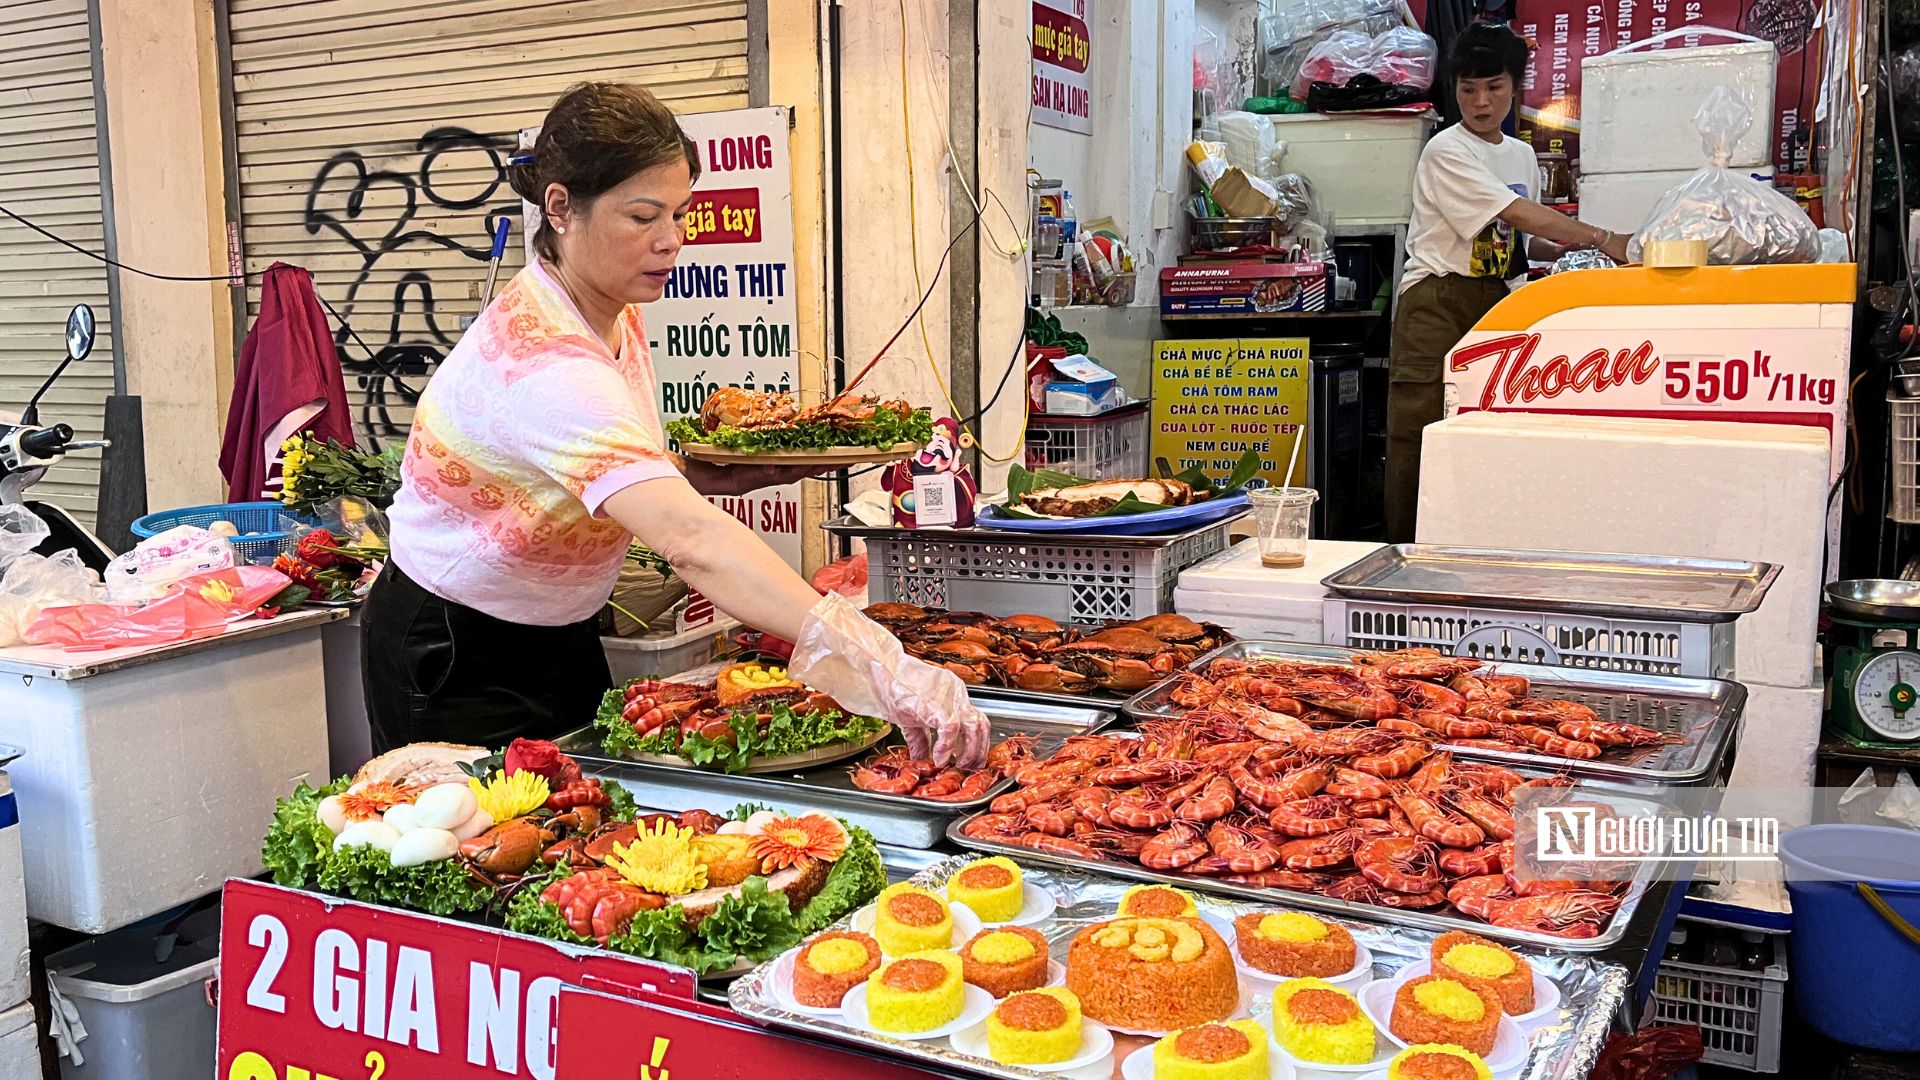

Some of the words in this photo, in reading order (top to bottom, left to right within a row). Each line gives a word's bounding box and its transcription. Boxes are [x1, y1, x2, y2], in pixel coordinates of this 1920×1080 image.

[1034, 20, 1056, 57] mực
[1057, 25, 1072, 61] giã
[1074, 32, 1089, 68] tay
[1554, 13, 1569, 44] NEM
[1552, 47, 1571, 69] HẢI
[1033, 69, 1051, 109] SẢN
[1053, 80, 1066, 118] HẠ
[1067, 84, 1089, 119] LONG
[1551, 73, 1570, 100] SẢN
[708, 134, 772, 172] LONG
[684, 201, 716, 241] giã
[721, 204, 757, 238] tay
[735, 263, 786, 305] THỊT
[1174, 269, 1230, 277] ANNAPURNA
[667, 312, 731, 357] RUỐC
[738, 316, 791, 358] TÔM
[1160, 347, 1187, 360] CHẢ
[1191, 349, 1222, 363] MỰC
[1237, 346, 1265, 360] CHẢ
[1162, 365, 1189, 378] CHẢ
[1247, 365, 1275, 378] CHẢ
[1280, 365, 1299, 378] CÁ
[1451, 333, 1660, 411] Thoan
[662, 371, 720, 414] RUỐ
[1181, 384, 1209, 397] CHẢ
[1213, 384, 1243, 397] TÔM
[1247, 386, 1278, 397] RAM
[1170, 402, 1197, 415] CHẢ
[1201, 403, 1219, 415] CÁ
[1223, 402, 1259, 415] THÁC
[1160, 423, 1187, 433] CUA
[1191, 421, 1216, 435] LỘT
[1230, 420, 1268, 433] RUỐC
[1272, 421, 1298, 433] TÉP
[1186, 441, 1215, 451] NEM
[1220, 441, 1247, 452] CUA
[760, 491, 797, 534] SẢN
[246, 914, 289, 1014] 2
[313, 928, 440, 1055] GIA
